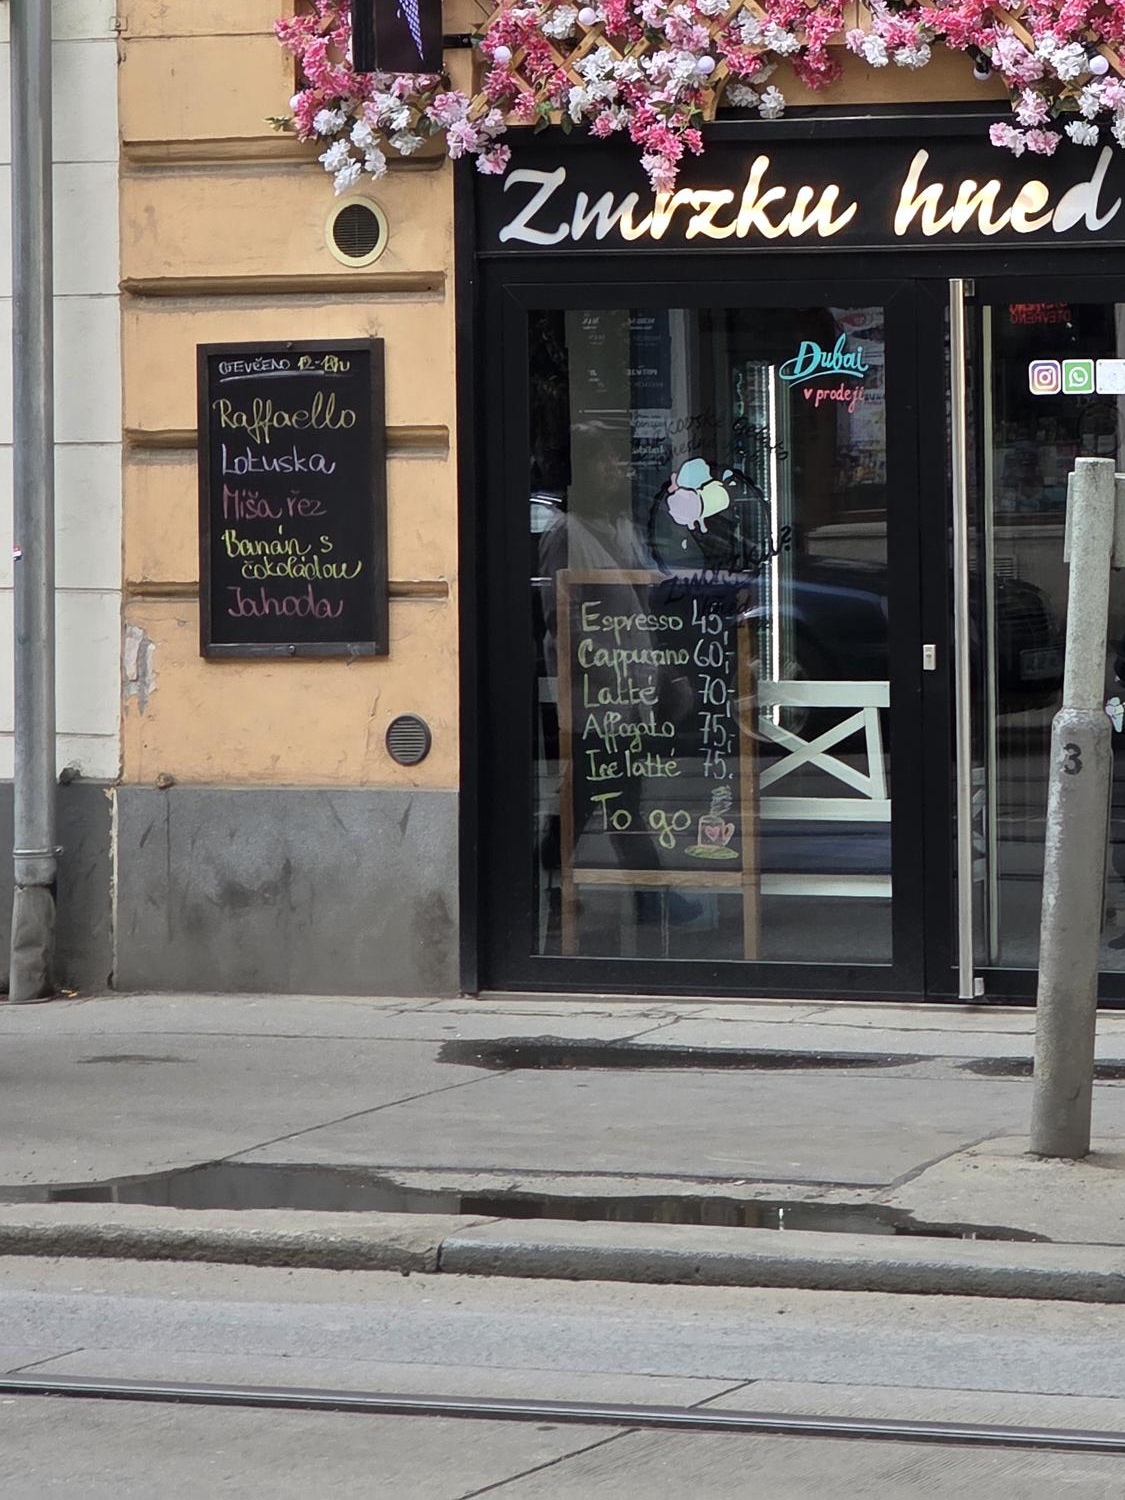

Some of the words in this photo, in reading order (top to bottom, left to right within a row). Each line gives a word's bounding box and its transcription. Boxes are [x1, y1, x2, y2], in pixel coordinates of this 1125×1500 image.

[499, 154, 858, 243] Zmrzku
[893, 146, 1123, 236] hned
[779, 333, 869, 388] Dubai
[212, 390, 356, 444] Raffaello
[803, 388, 813, 400] v
[815, 382, 865, 413] prodeji
[320, 535, 333, 553] s
[226, 583, 344, 619] Jahoda
[582, 601, 683, 645] Espresso
[1063, 743, 1082, 775] 3
[590, 790, 632, 831] To
[649, 809, 692, 849] go
